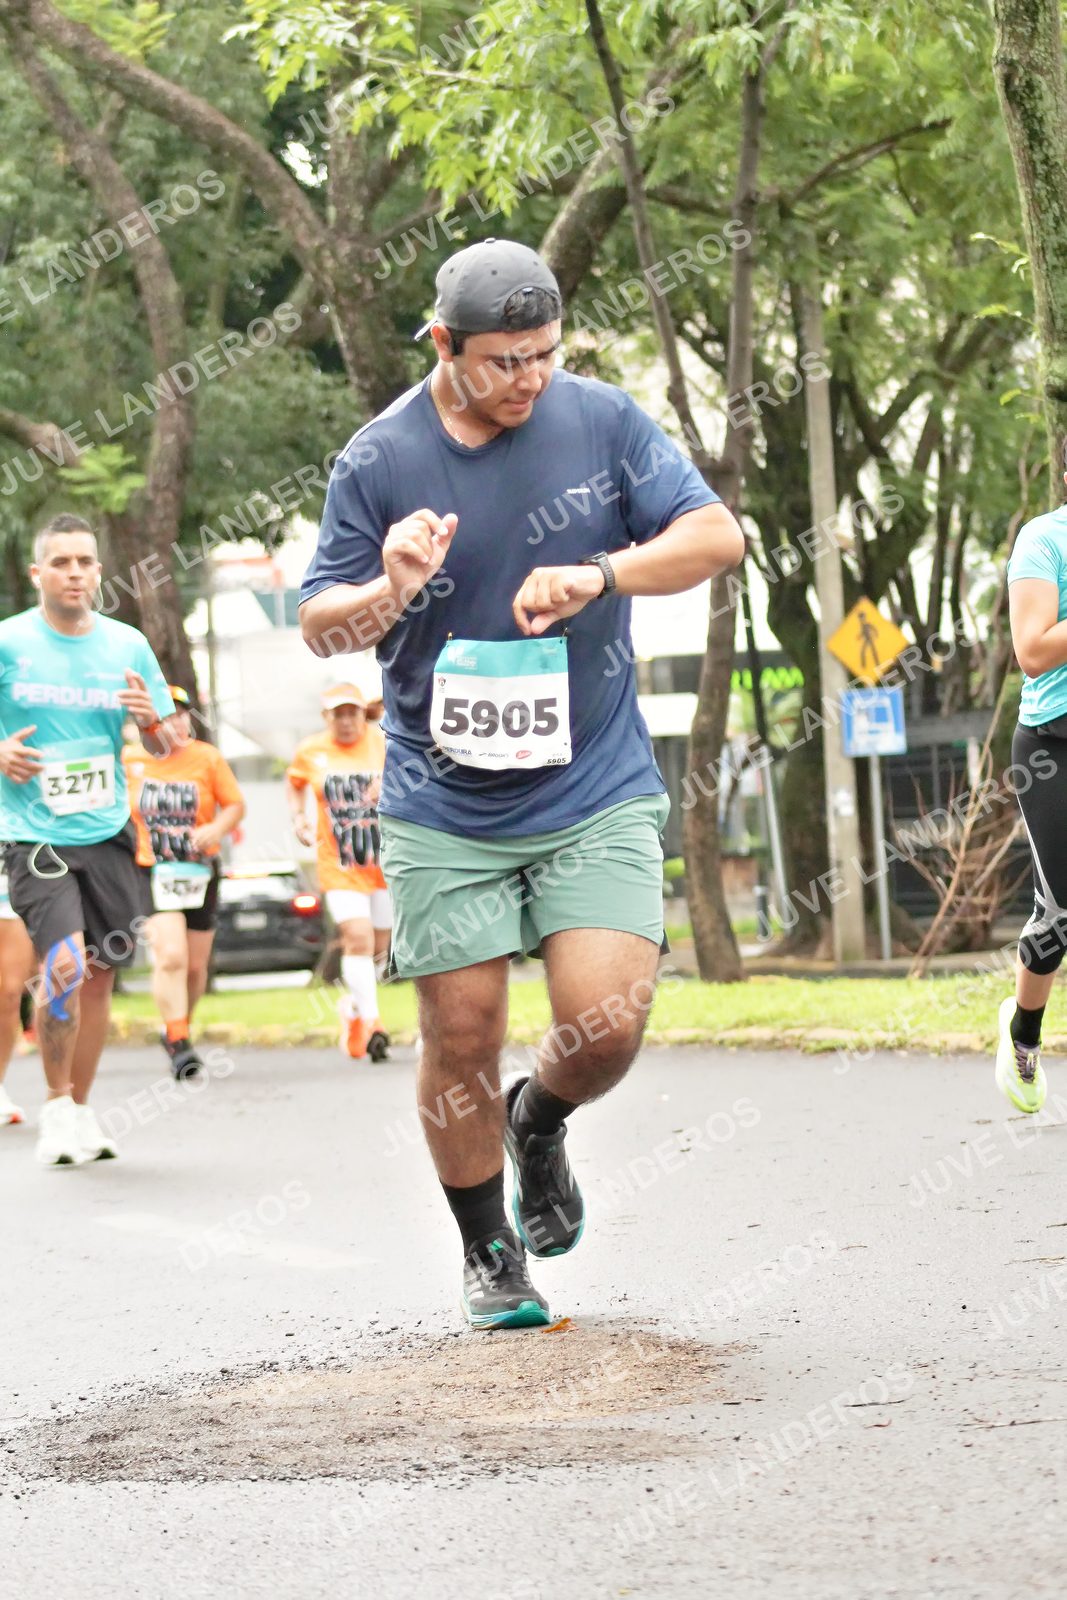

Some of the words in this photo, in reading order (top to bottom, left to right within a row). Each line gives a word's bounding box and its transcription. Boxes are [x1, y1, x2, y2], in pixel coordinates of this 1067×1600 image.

[12, 682, 122, 710] PERDURA
[439, 697, 560, 739] 5905
[546, 757, 567, 765] 5905
[47, 770, 109, 797] 3271
